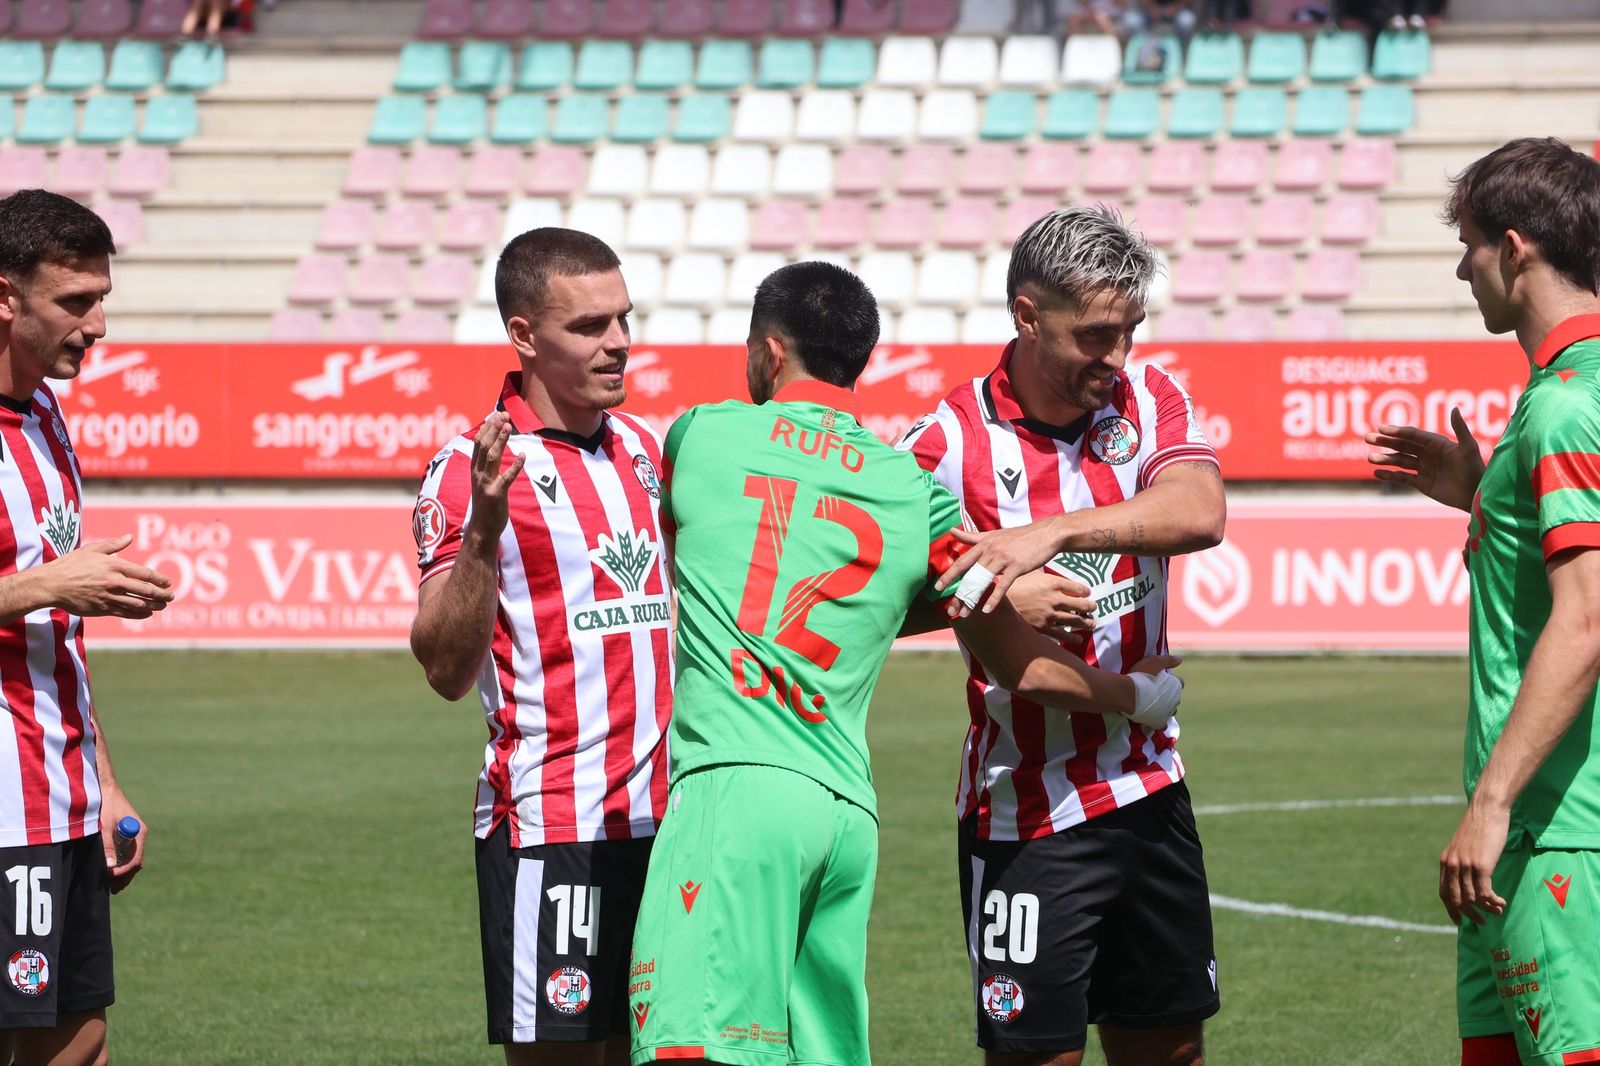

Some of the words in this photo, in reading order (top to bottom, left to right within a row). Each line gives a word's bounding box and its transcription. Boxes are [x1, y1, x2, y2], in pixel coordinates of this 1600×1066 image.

[1282, 356, 1428, 384] DESGUACES
[69, 404, 199, 457] regorio
[252, 404, 472, 458] sangregorio
[769, 416, 865, 473] RUFO
[136, 514, 231, 550] PAGO
[143, 551, 229, 602] OS
[247, 539, 418, 602] VIVA
[736, 475, 884, 672] 12
[1095, 575, 1155, 618] RURAL
[574, 607, 629, 631] CAJA
[630, 602, 671, 623] RURA
[5, 865, 52, 936] 16
[546, 885, 600, 956] 14
[983, 889, 1039, 964] 20
